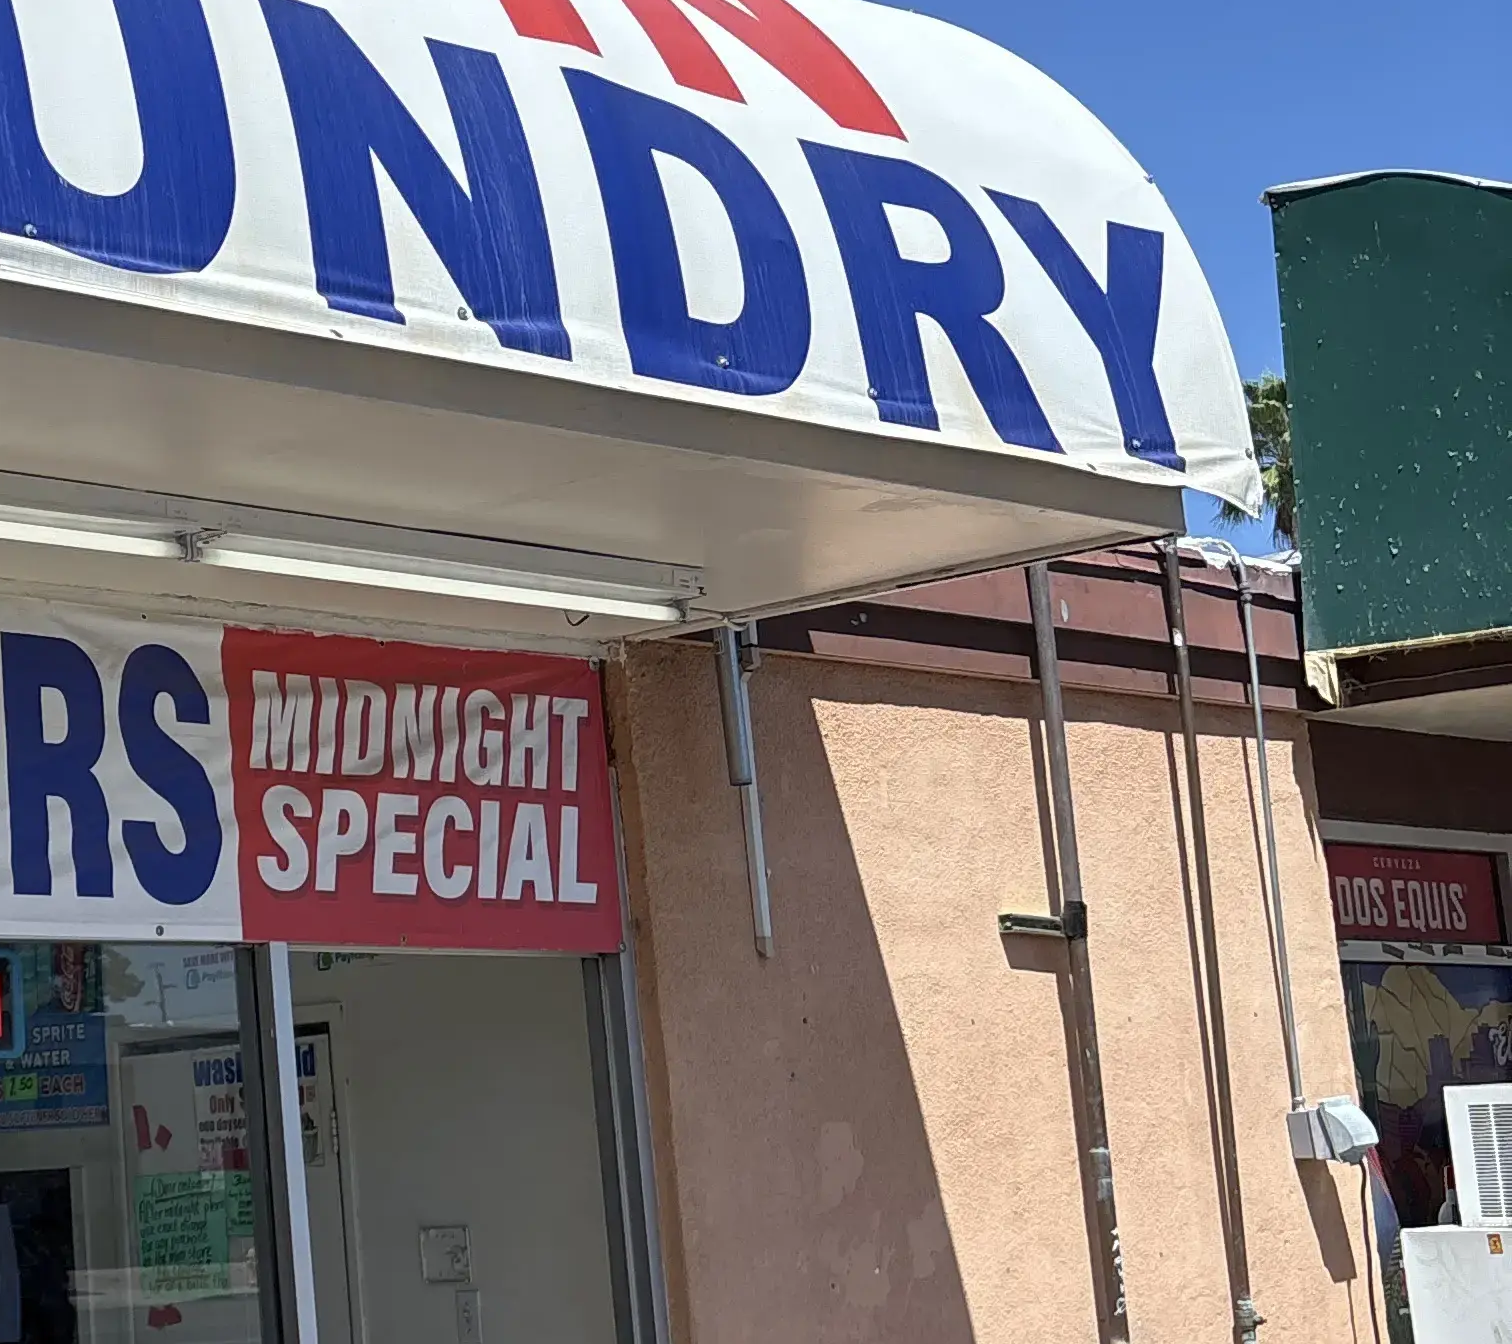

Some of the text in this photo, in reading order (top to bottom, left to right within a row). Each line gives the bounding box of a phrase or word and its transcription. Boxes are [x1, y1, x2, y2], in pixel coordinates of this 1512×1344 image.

[249, 669, 589, 792] MIDNIGHT
[256, 784, 599, 905] SPECIAL
[1373, 857, 1421, 870] CERVEZA
[1335, 875, 1467, 933] DOS EQUIS
[32, 1023, 86, 1044] SPRITE
[21, 1049, 71, 1070] WATER
[40, 1073, 86, 1097] EACH
